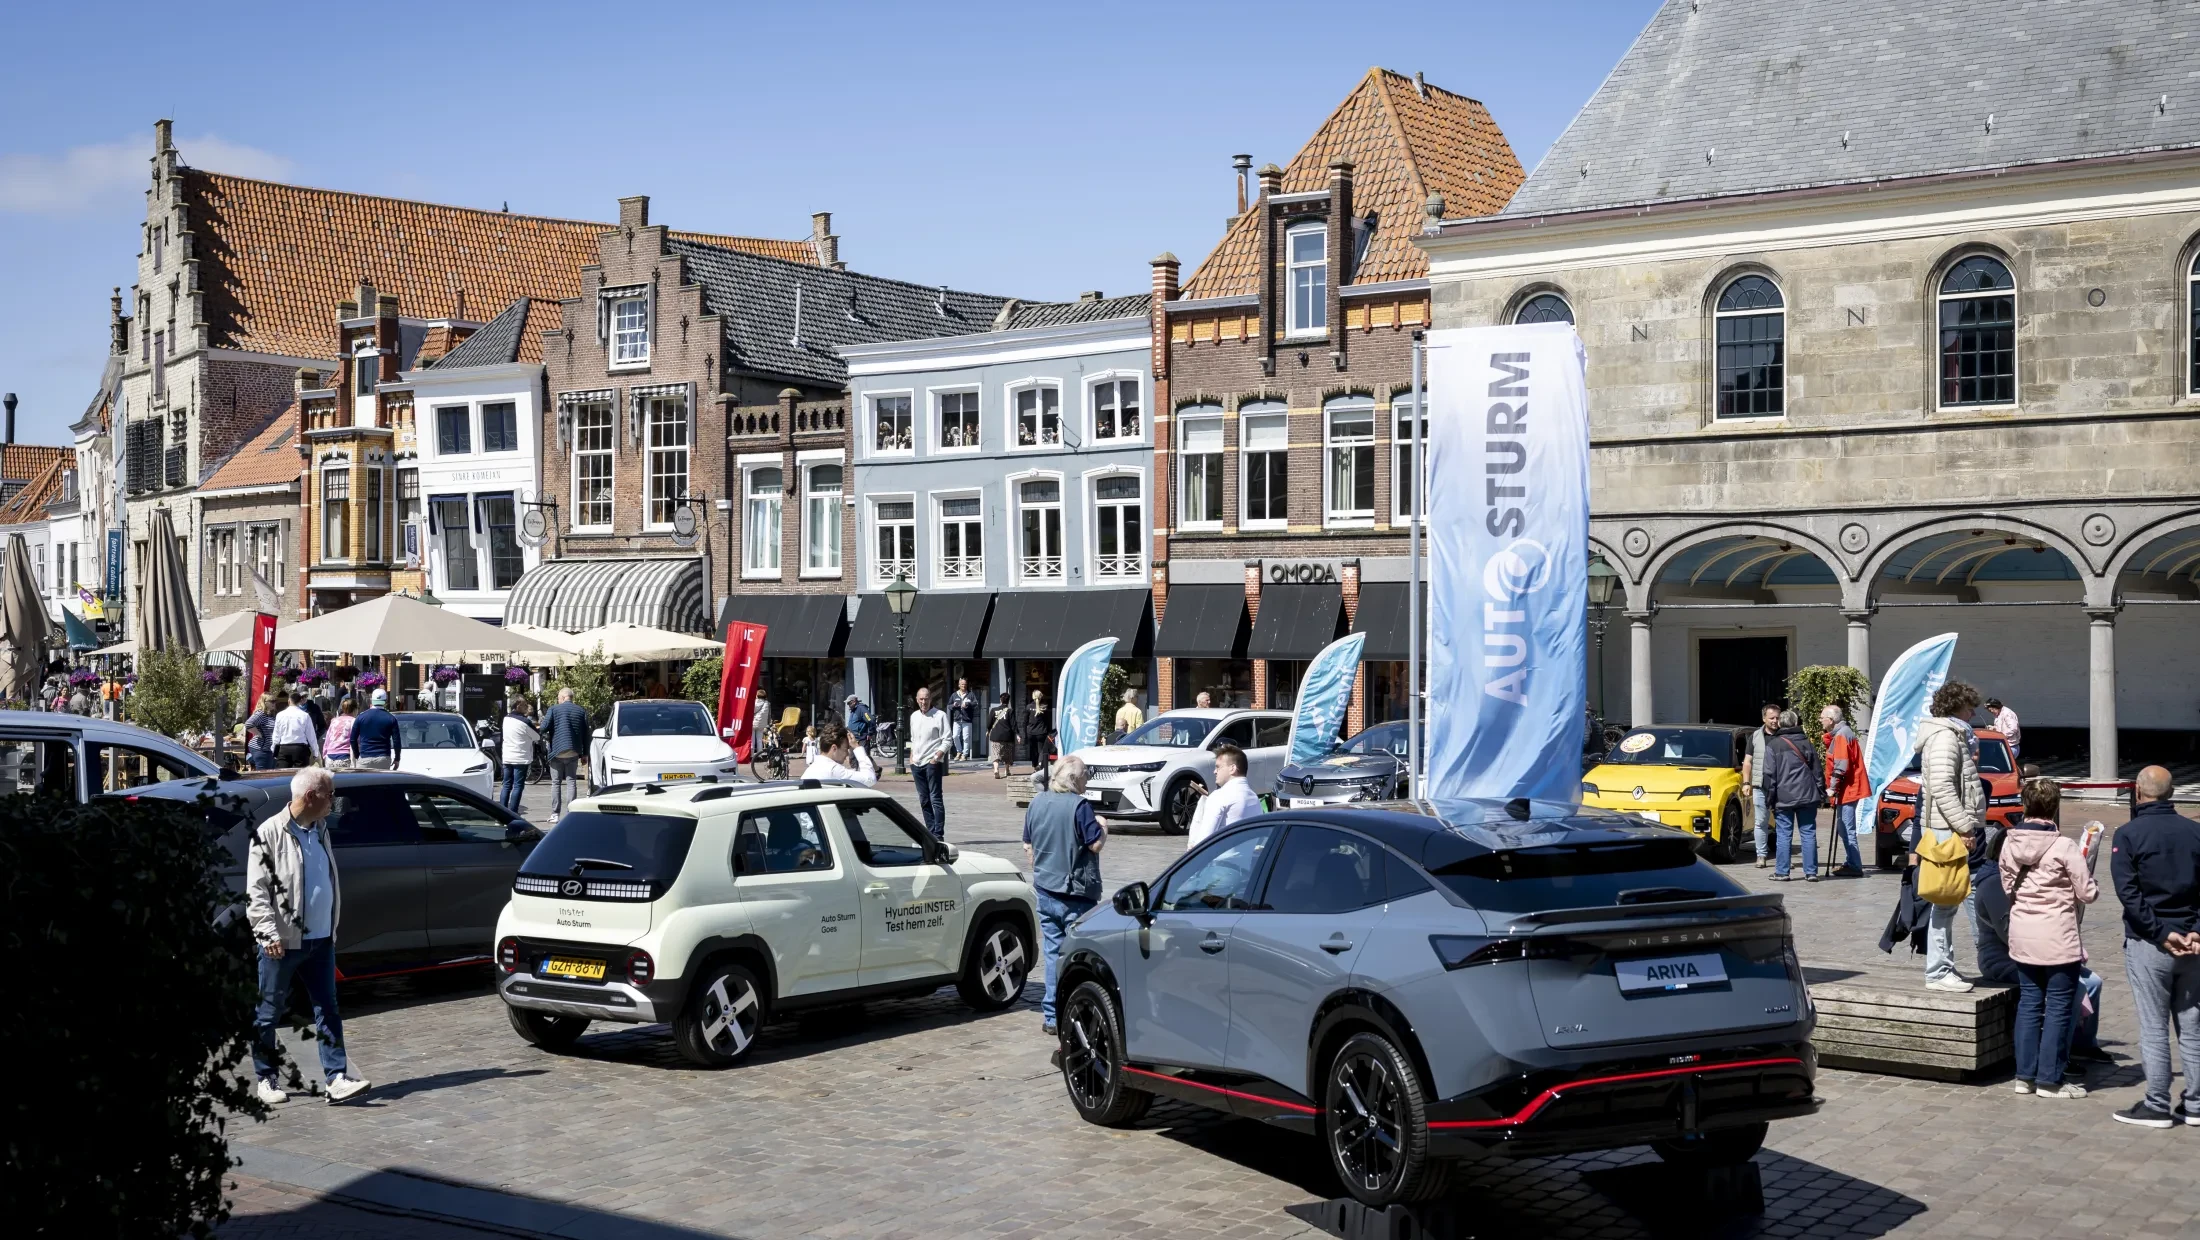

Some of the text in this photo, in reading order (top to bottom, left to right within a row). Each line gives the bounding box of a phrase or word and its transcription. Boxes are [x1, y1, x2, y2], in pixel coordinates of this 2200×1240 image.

[1486, 351, 1531, 538] STURM
[1270, 563, 1338, 584] OMODA
[480, 653, 505, 662] EARTH
[693, 648, 721, 657] EARTH
[1081, 665, 1105, 750] toKievit
[821, 913, 856, 923] Auto Sturm
[885, 900, 956, 920] Hyundai INSTER
[556, 919, 592, 928] Auto Sturm
[821, 925, 837, 934] Goes
[886, 915, 945, 932] Test hem zelf.
[1628, 931, 1721, 946] NISSAN
[551, 958, 603, 976] GZH-88-N
[1647, 962, 1700, 982] ARIYA
